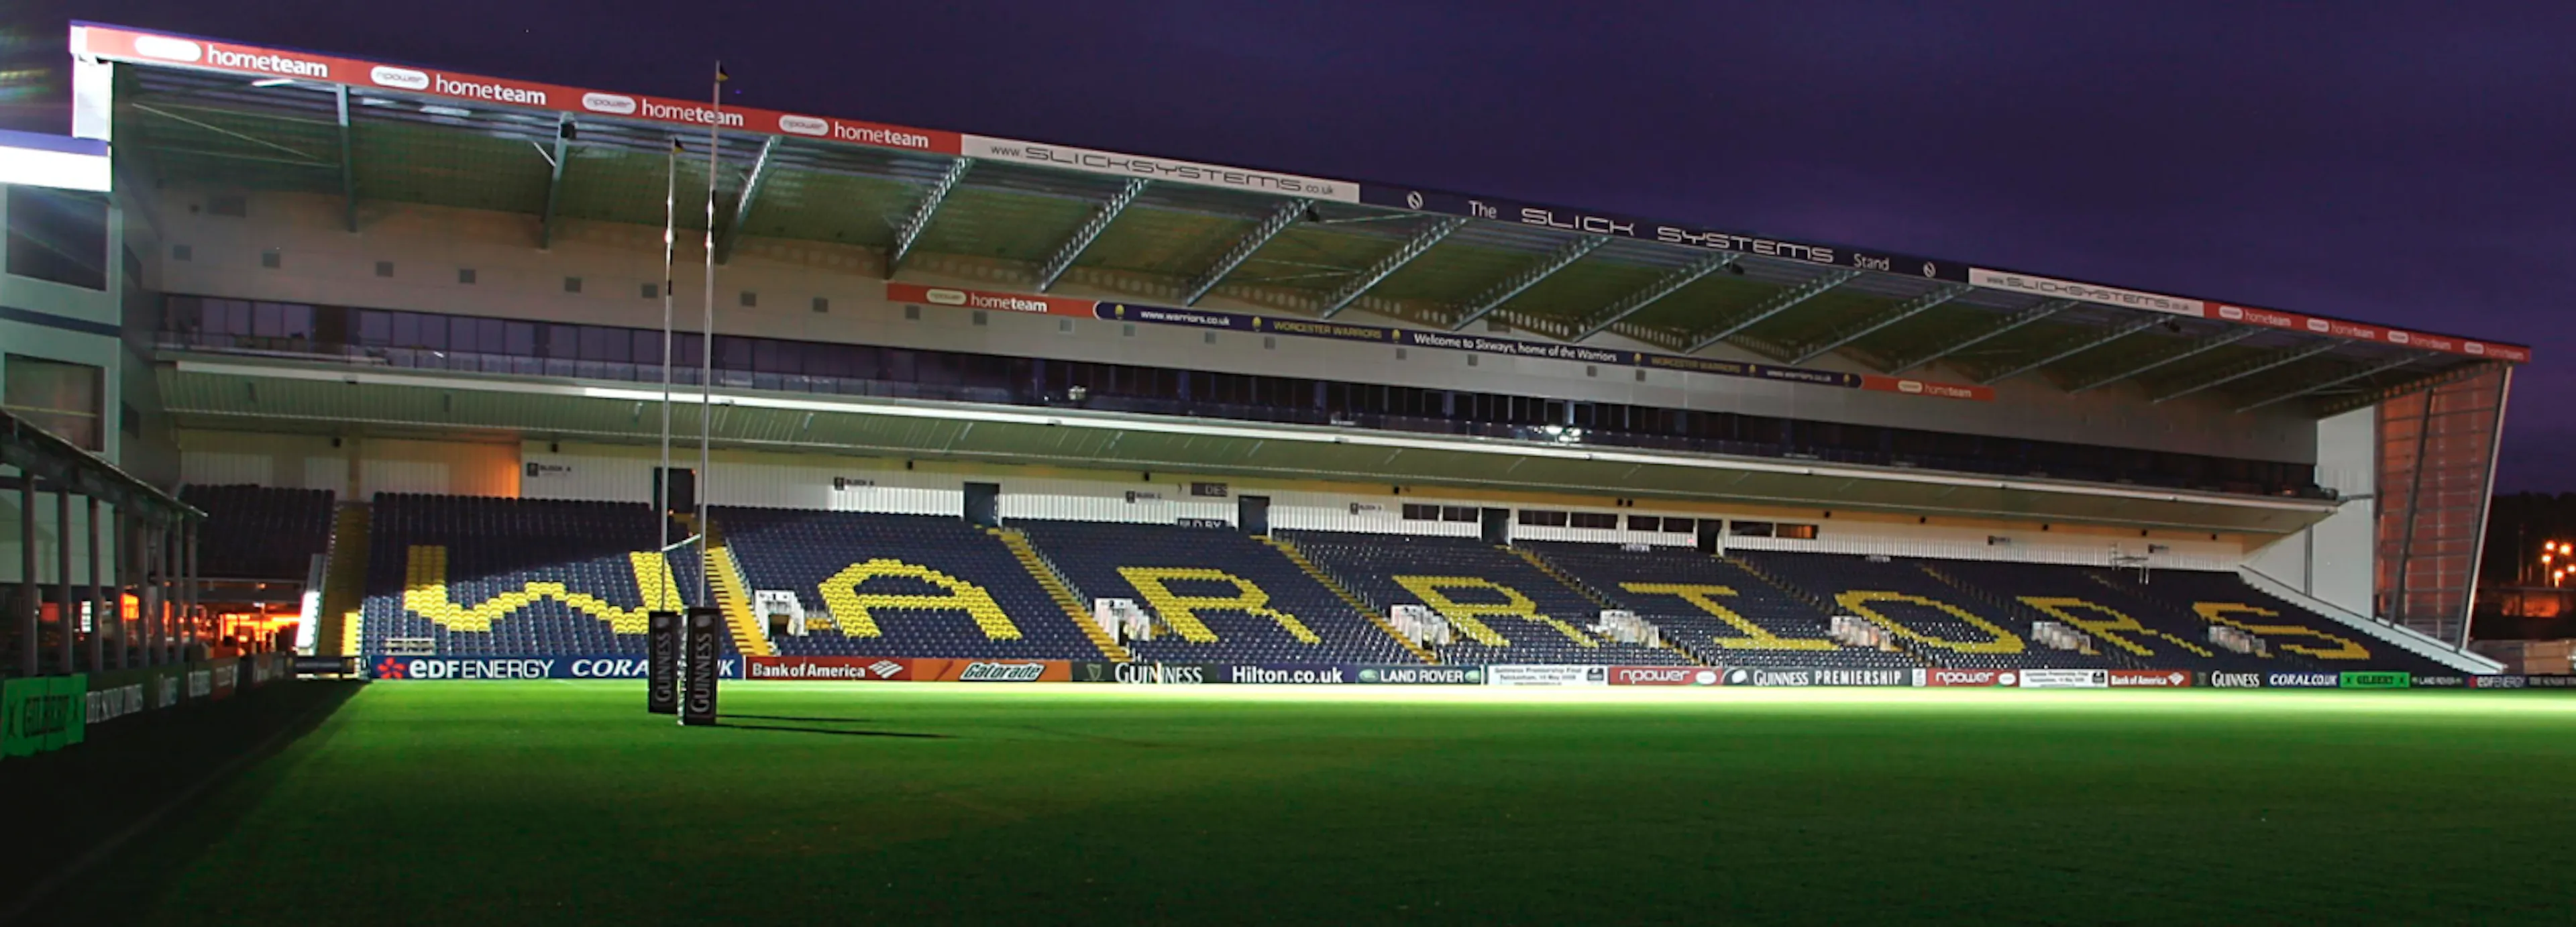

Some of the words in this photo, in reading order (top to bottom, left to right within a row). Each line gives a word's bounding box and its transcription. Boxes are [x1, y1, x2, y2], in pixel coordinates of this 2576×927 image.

[208, 44, 328, 78] hometeam
[436, 74, 547, 105] hometeam
[642, 99, 743, 127] hometeam
[834, 121, 928, 149] hometeam
[1468, 200, 1497, 219] The
[1521, 208, 1635, 236] SLICK
[1657, 226, 1834, 263] SYSTEMS
[1854, 252, 1890, 272] Stand
[971, 292, 1048, 313] hometeam
[1273, 320, 1330, 335] WORCESTER
[1333, 325, 1382, 339] WARRIORS
[1414, 333, 1461, 349] Welcome
[1463, 339, 1474, 349] to
[1518, 344, 1546, 357] home
[1548, 345, 1560, 357] of
[1560, 346, 1575, 358] the
[1578, 349, 1617, 363] Warriors
[405, 545, 2371, 660] WARRIORS
[655, 632, 672, 702] GUINNESS
[690, 633, 712, 713] GUINNESS
[752, 661, 788, 677] Bank
[790, 663, 805, 677] of
[807, 663, 865, 677] America
[961, 662, 1044, 680] Gatorade
[1114, 662, 1203, 684] GUINNESS
[1232, 665, 1344, 684] Hilton.co.uk
[1380, 669, 1416, 682] LAND
[1419, 669, 1464, 682] ROVER
[1619, 669, 1690, 684] npower
[1935, 671, 1994, 684] npower
[1753, 670, 1809, 686] GUINNESS
[1815, 670, 1902, 686] PREMIERSHIP
[2211, 671, 2260, 688] GUINNESS
